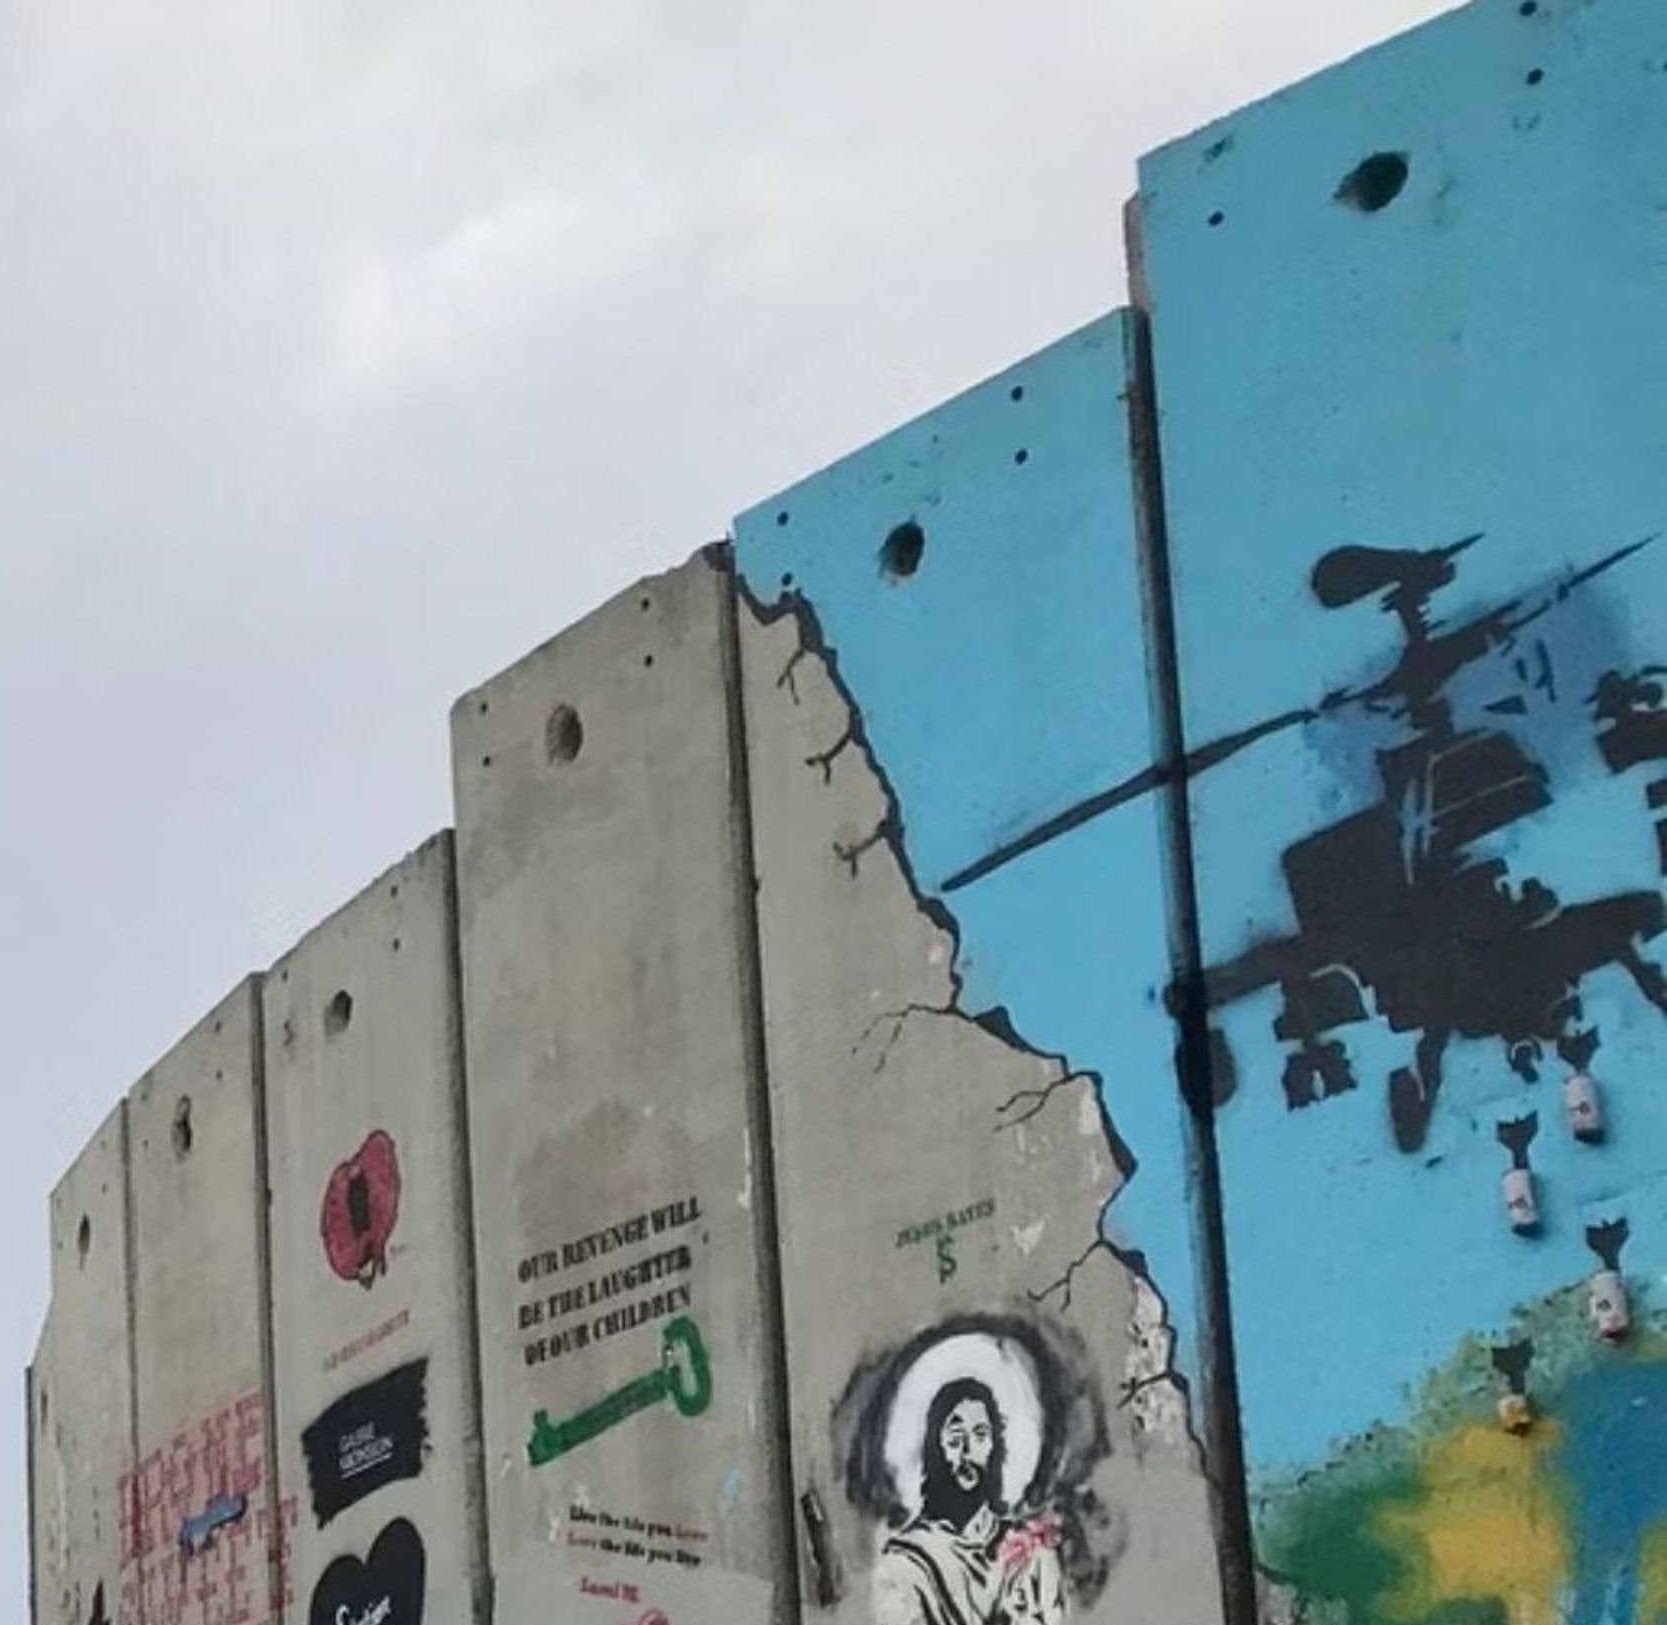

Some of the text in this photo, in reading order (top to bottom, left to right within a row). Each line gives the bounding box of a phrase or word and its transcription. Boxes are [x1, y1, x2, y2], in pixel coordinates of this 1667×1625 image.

[518, 1196, 702, 1283] OUR REVENGE WILL
[519, 1245, 691, 1329] BE THE LAUGHTER
[524, 1338, 548, 1366] OF
[593, 1282, 691, 1341] CHILDREN
[647, 1522, 671, 1540] you
[647, 1548, 672, 1565] you
